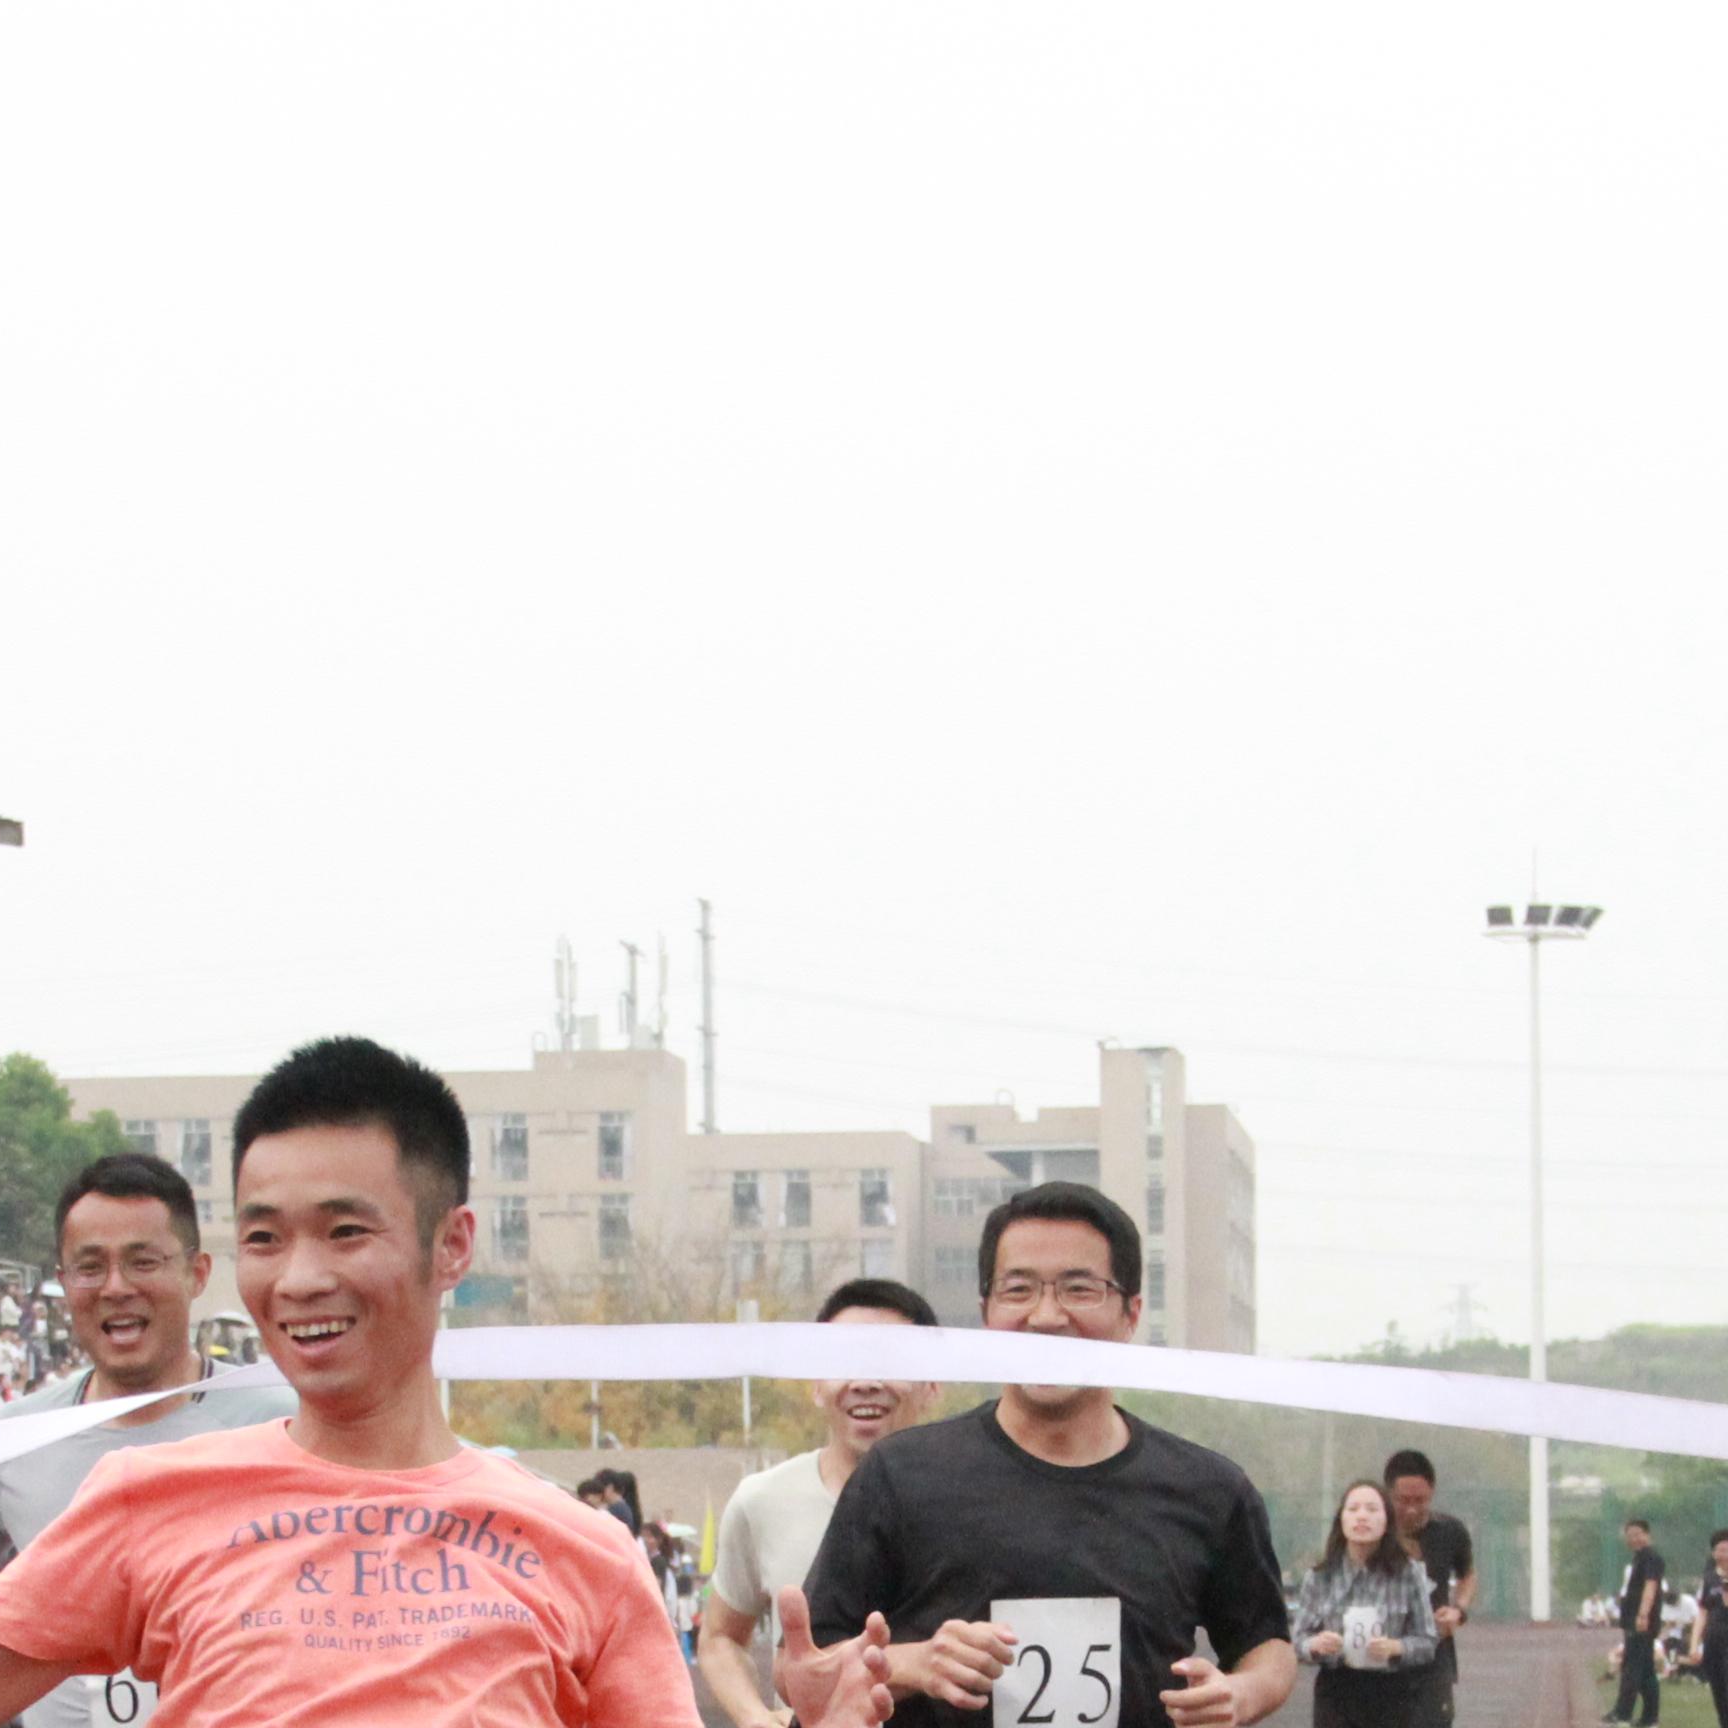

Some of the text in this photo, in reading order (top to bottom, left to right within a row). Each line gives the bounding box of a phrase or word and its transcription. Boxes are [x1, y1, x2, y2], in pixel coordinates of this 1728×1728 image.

[227, 1502, 541, 1579] Abercrombie
[296, 1549, 471, 1597] & Fitch
[240, 1612, 289, 1629] REG.
[399, 1602, 532, 1626] TRADEMARK
[305, 1633, 372, 1652] QUALITY
[377, 1634, 424, 1649] SINCE
[1015, 1643, 1113, 1725] 25
